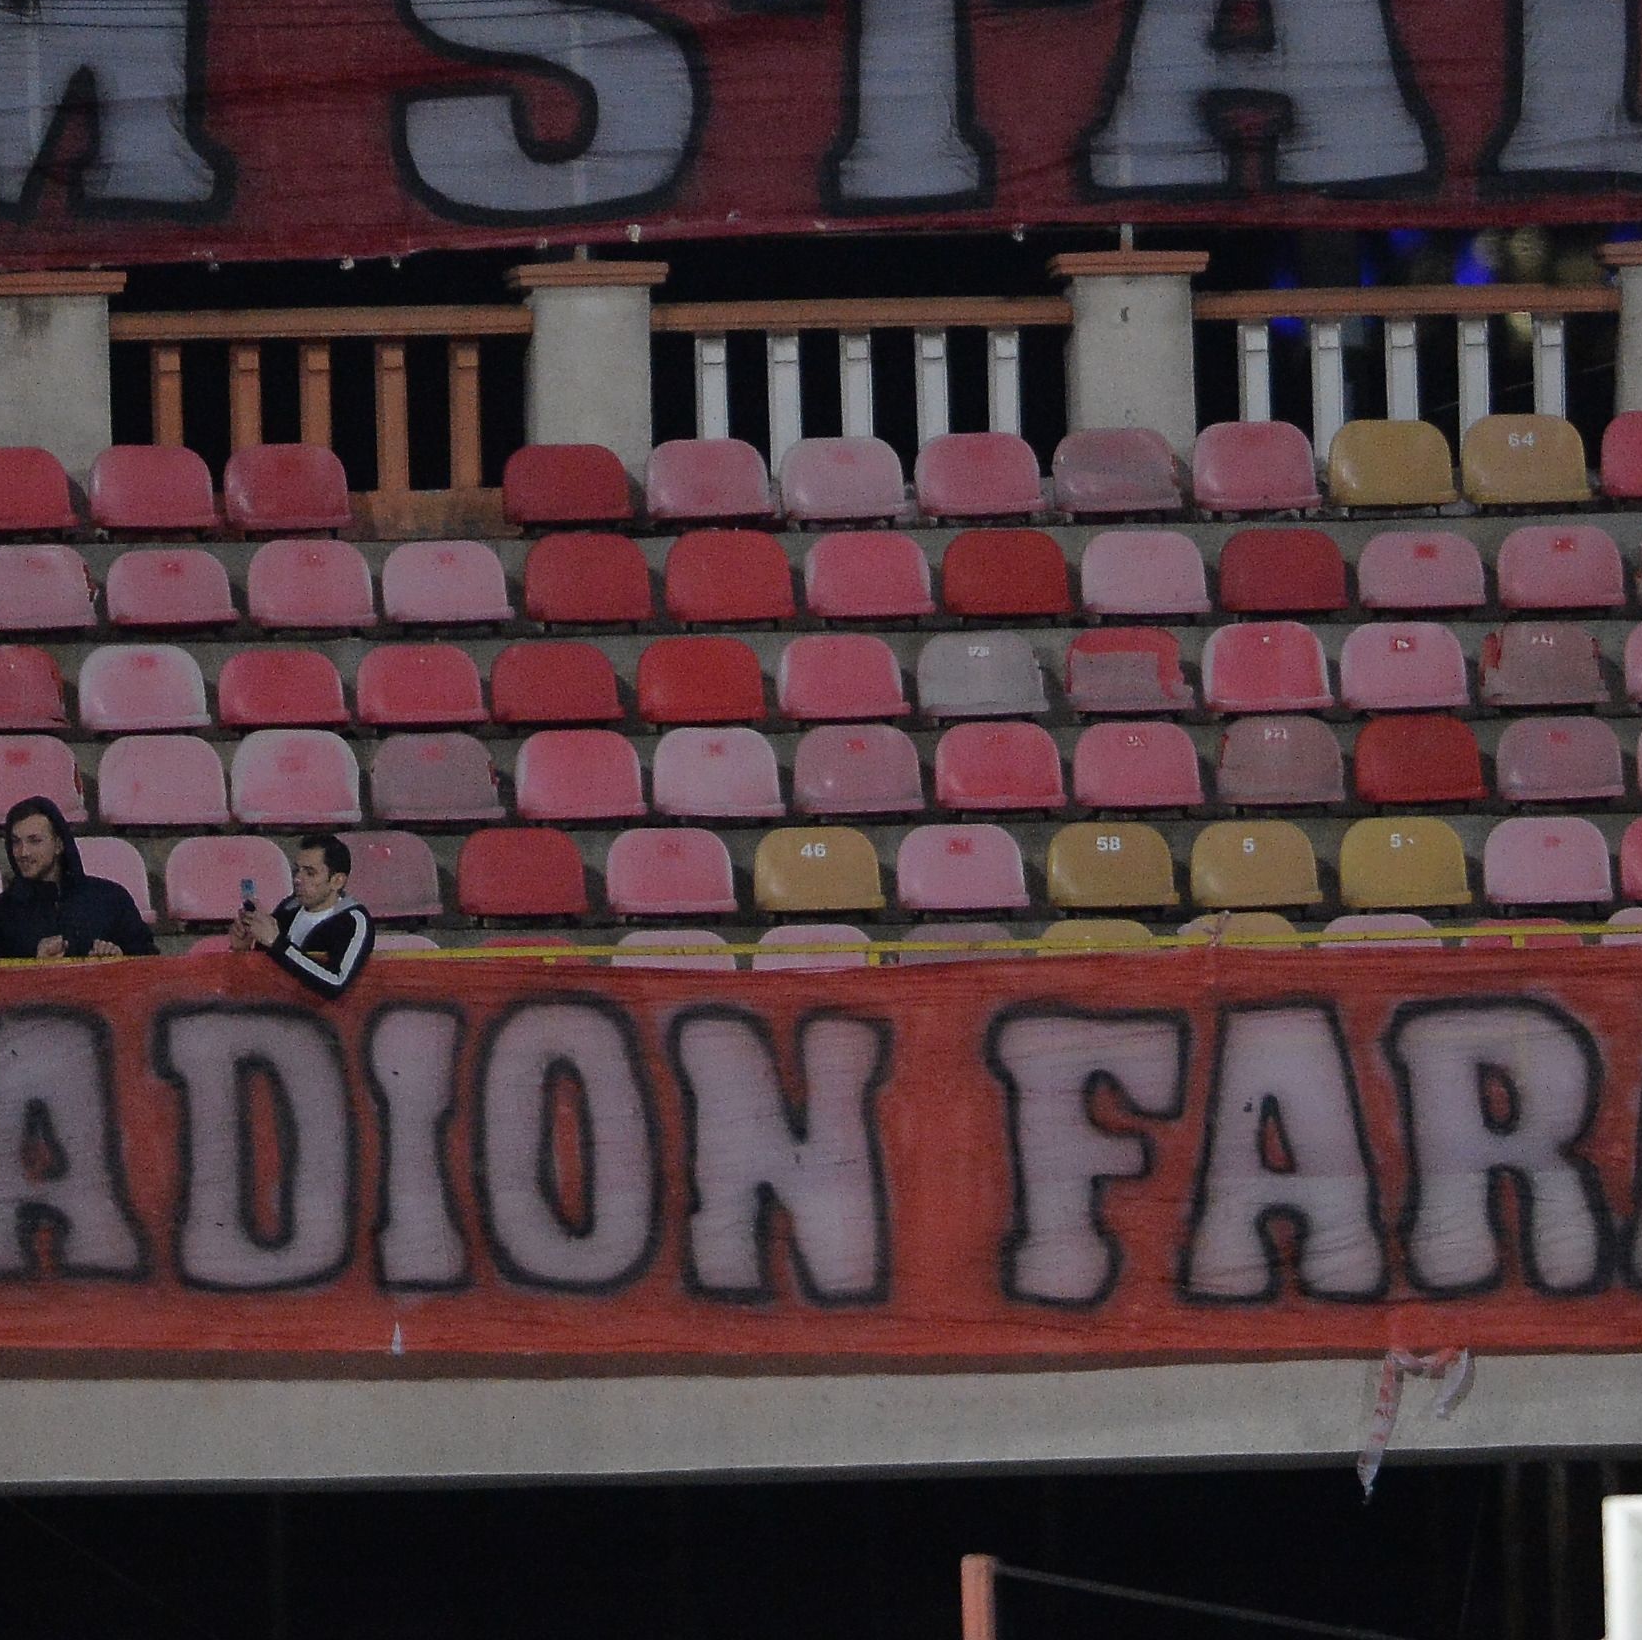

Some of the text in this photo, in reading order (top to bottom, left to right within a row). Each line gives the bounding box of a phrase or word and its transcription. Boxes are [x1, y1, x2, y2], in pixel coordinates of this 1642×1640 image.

[1508, 432, 1535, 447] 64
[800, 843, 827, 858] 46
[1096, 836, 1121, 852] 58
